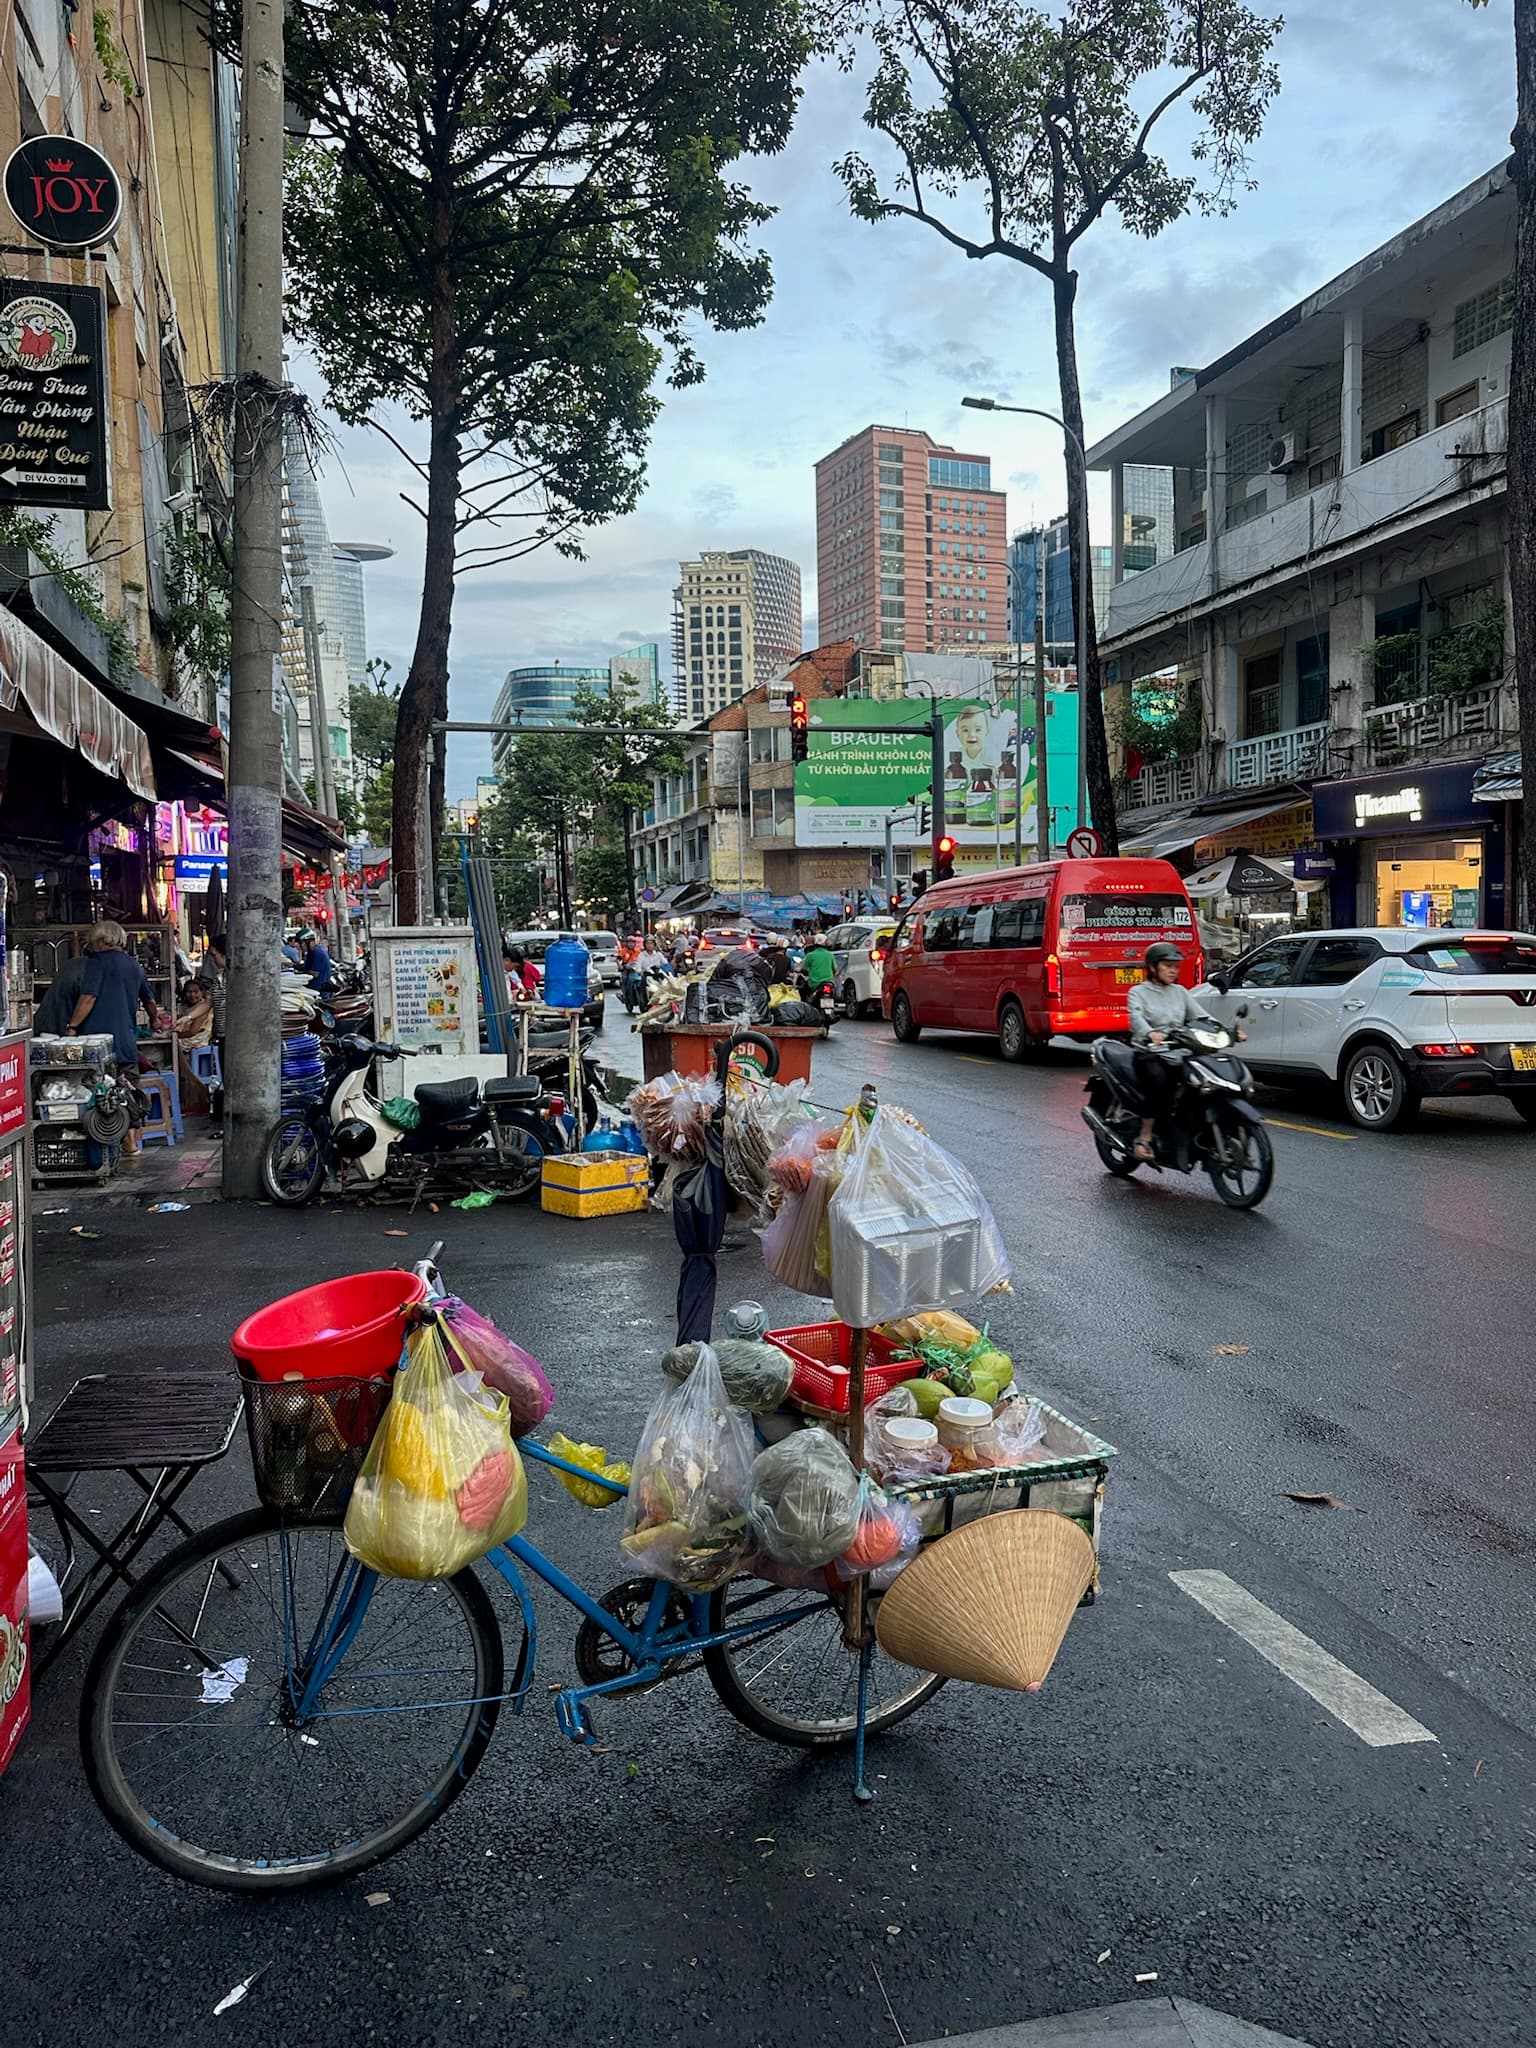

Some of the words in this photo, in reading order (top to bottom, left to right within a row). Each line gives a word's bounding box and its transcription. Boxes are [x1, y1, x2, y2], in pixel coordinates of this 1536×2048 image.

[29, 176, 109, 218] JOY
[32, 401, 94, 423] Phòng
[18, 421, 68, 443] Nhậu
[55, 445, 91, 464] Quê
[841, 748, 874, 760] TRÌNH
[876, 748, 908, 760] KHÔN
[825, 762, 853, 775] KHỞI
[855, 761, 877, 775] ĐẦU
[880, 762, 900, 775] TỐT
[902, 762, 931, 775] NHẤT
[1355, 787, 1422, 819] Vinamilk
[1104, 906, 1136, 916] CÔNG
[1137, 907, 1153, 916] TY
[1175, 911, 1189, 922] 172
[1136, 917, 1174, 927] TRANG
